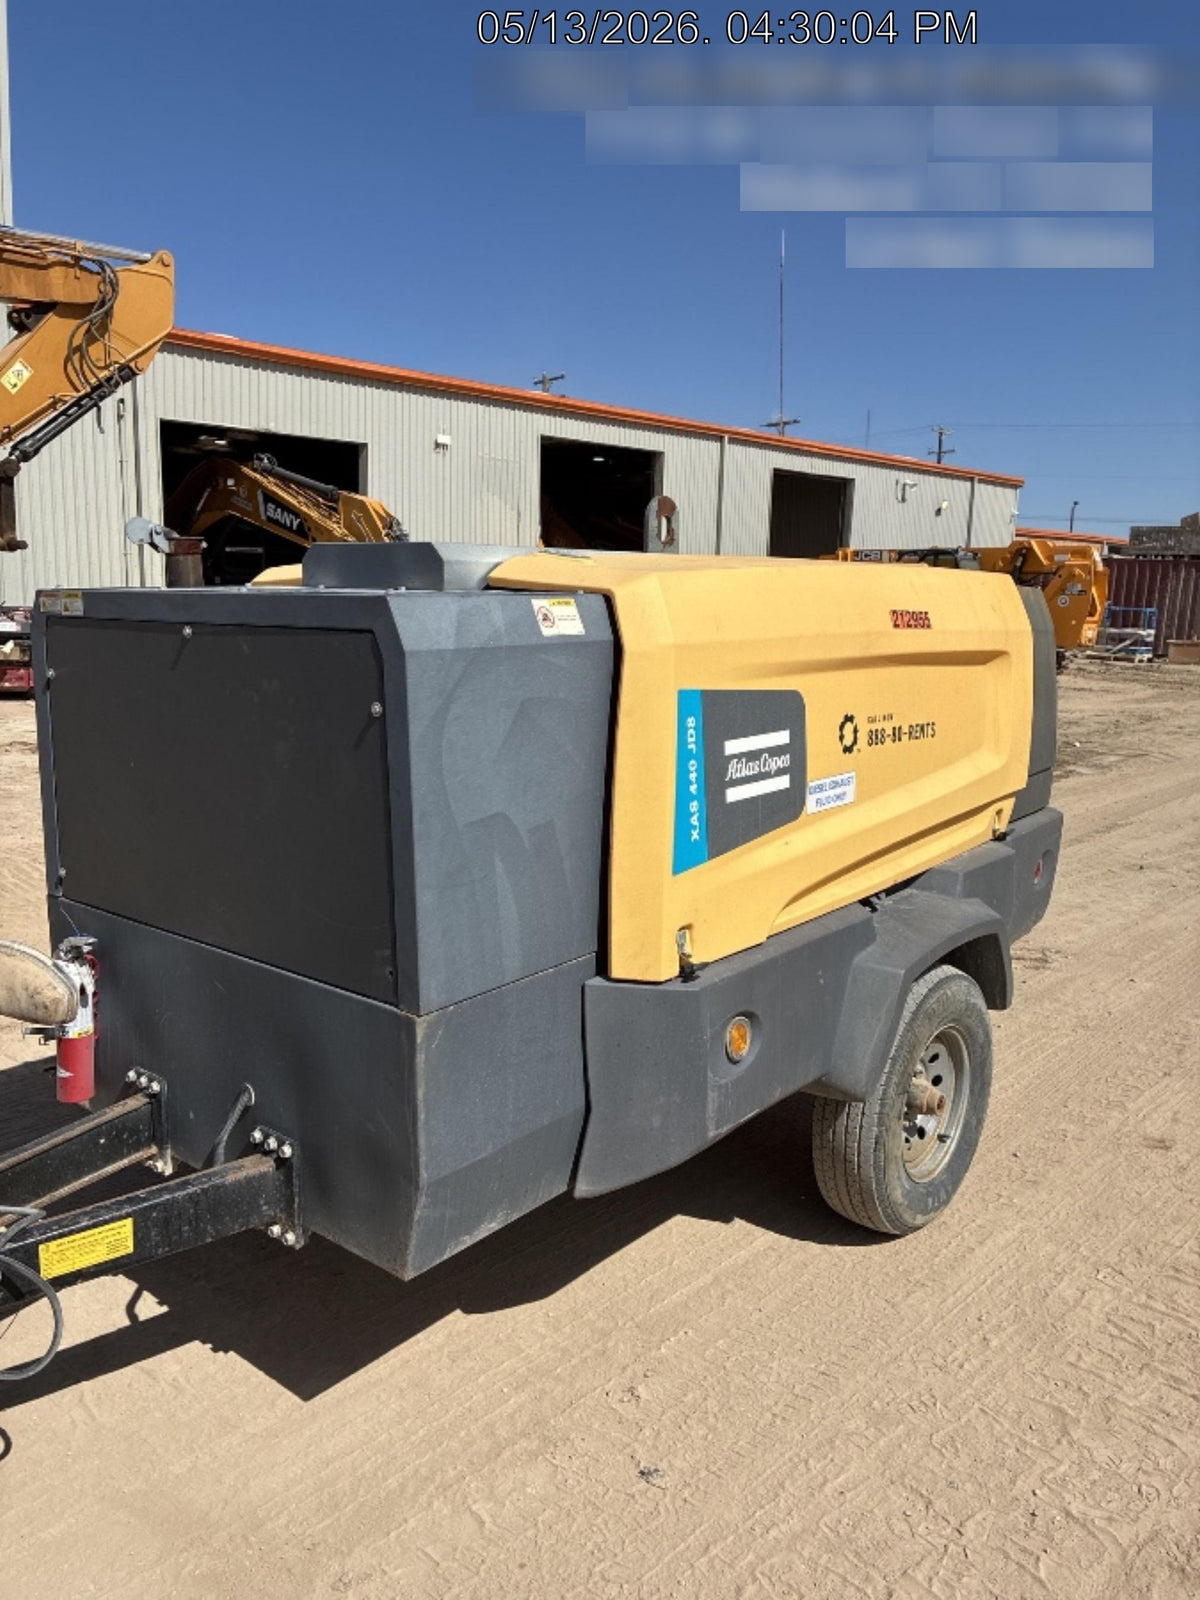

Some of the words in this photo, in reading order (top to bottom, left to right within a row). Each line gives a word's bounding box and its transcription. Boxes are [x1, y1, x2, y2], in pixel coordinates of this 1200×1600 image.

[266, 502, 301, 531] SANY
[854, 550, 881, 561] JCB
[686, 716, 696, 754] JD8
[688, 759, 698, 795] 440
[725, 757, 760, 781] Atlas
[760, 753, 790, 775] Copco
[689, 800, 700, 842] XAS
